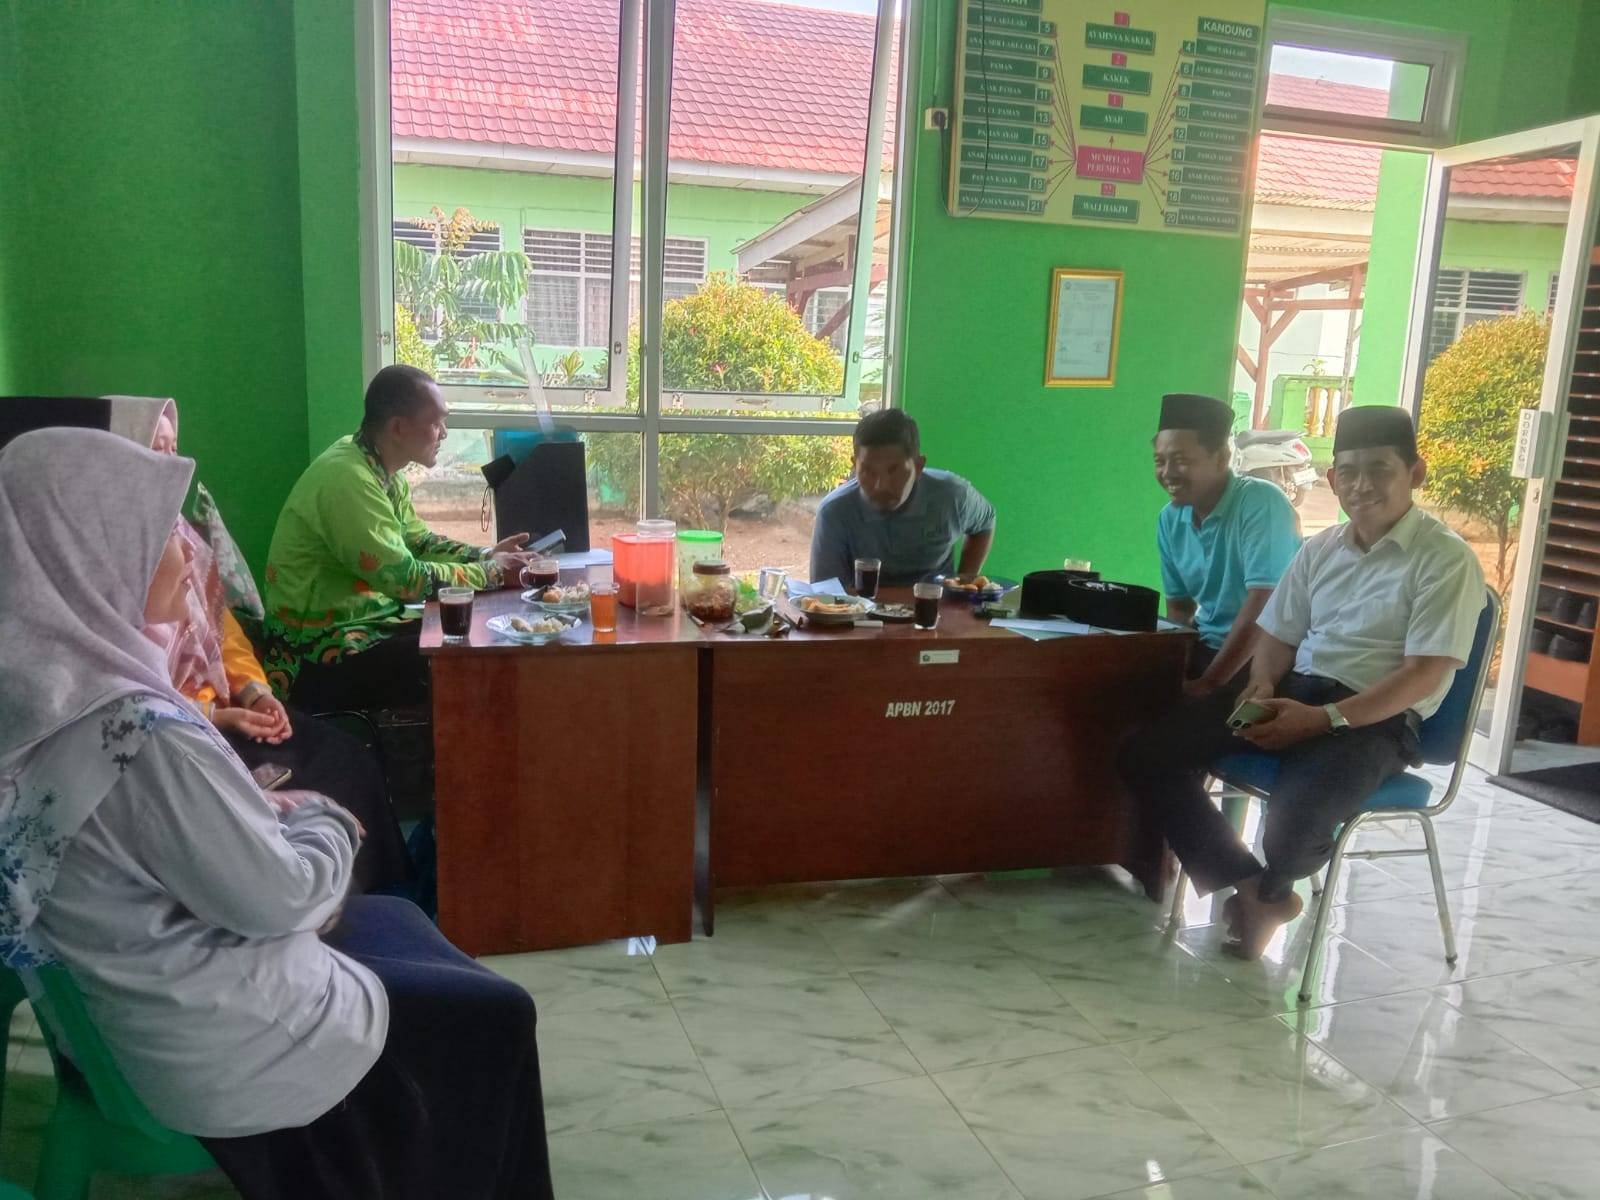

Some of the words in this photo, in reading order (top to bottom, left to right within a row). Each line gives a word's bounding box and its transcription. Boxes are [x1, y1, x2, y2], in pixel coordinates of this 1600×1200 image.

[1044, 23, 1051, 32] 5
[1204, 20, 1252, 38] KANDUNG
[1043, 46, 1050, 56] 7
[1185, 42, 1192, 52] 4
[1042, 68, 1050, 78] 9
[1104, 72, 1129, 85] KAKEK
[1039, 89, 1048, 99] 11
[1180, 86, 1188, 96] 8
[1038, 112, 1049, 122] 13
[1178, 107, 1187, 117] 10
[1104, 113, 1123, 125] AYAH
[1175, 129, 1185, 139] 12
[1037, 134, 1048, 145] 15
[1173, 150, 1183, 160] 14
[1035, 156, 1046, 167] 17
[1171, 171, 1181, 181] 16
[1033, 178, 1044, 189] 19
[1168, 191, 1179, 202] 18
[1030, 200, 1041, 211] 21
[1166, 213, 1176, 223] 20
[1518, 412, 1532, 463] DORONG
[885, 701, 922, 718] APBN
[924, 699, 956, 716] 2017
